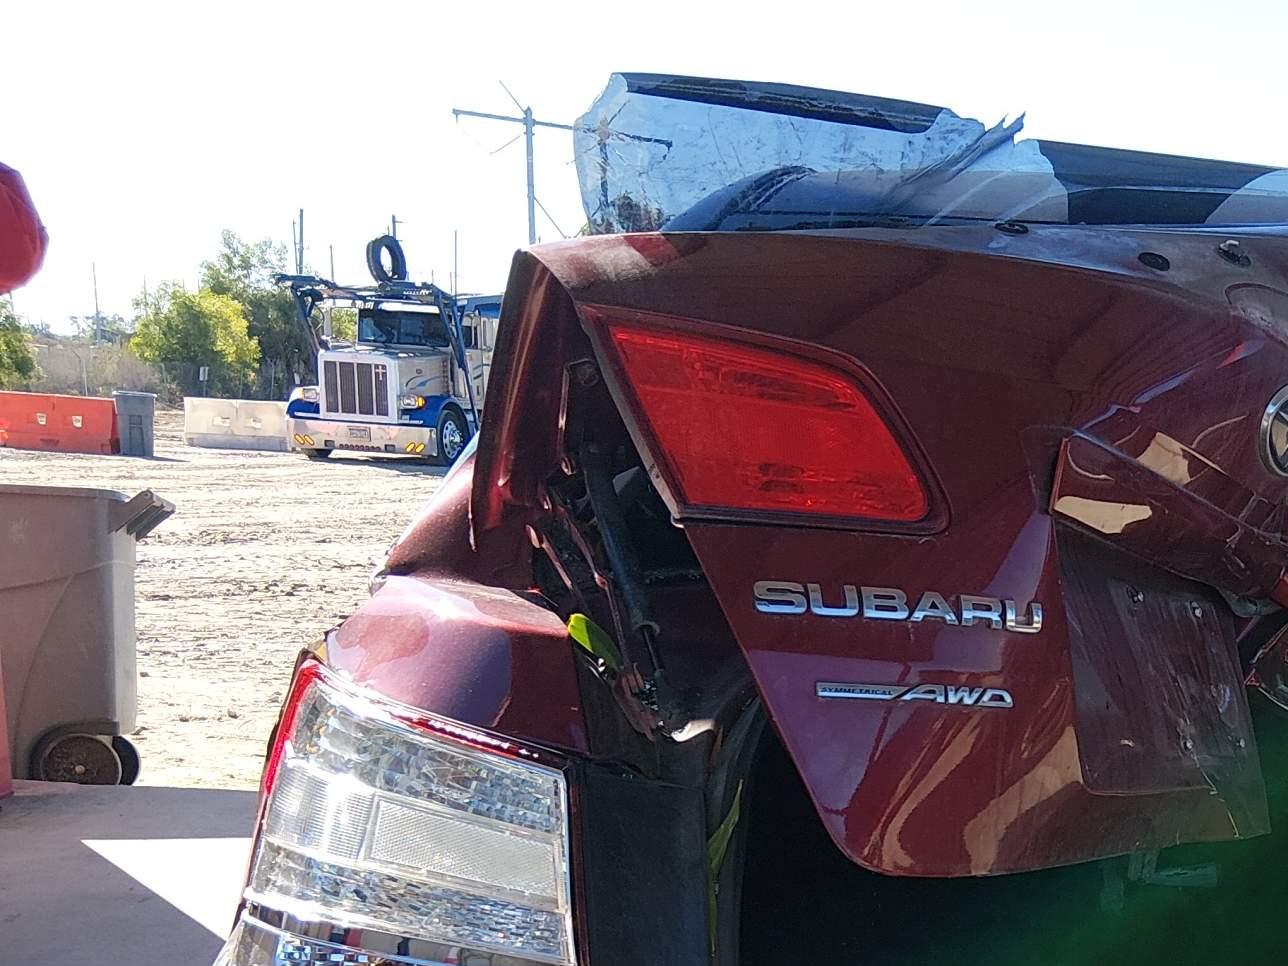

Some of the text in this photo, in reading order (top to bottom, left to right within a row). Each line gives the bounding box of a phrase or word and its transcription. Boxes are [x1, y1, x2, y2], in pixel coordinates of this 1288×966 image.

[752, 580, 1044, 633] SUBARU
[819, 683, 1015, 708] SYMMETRICAL AWD
